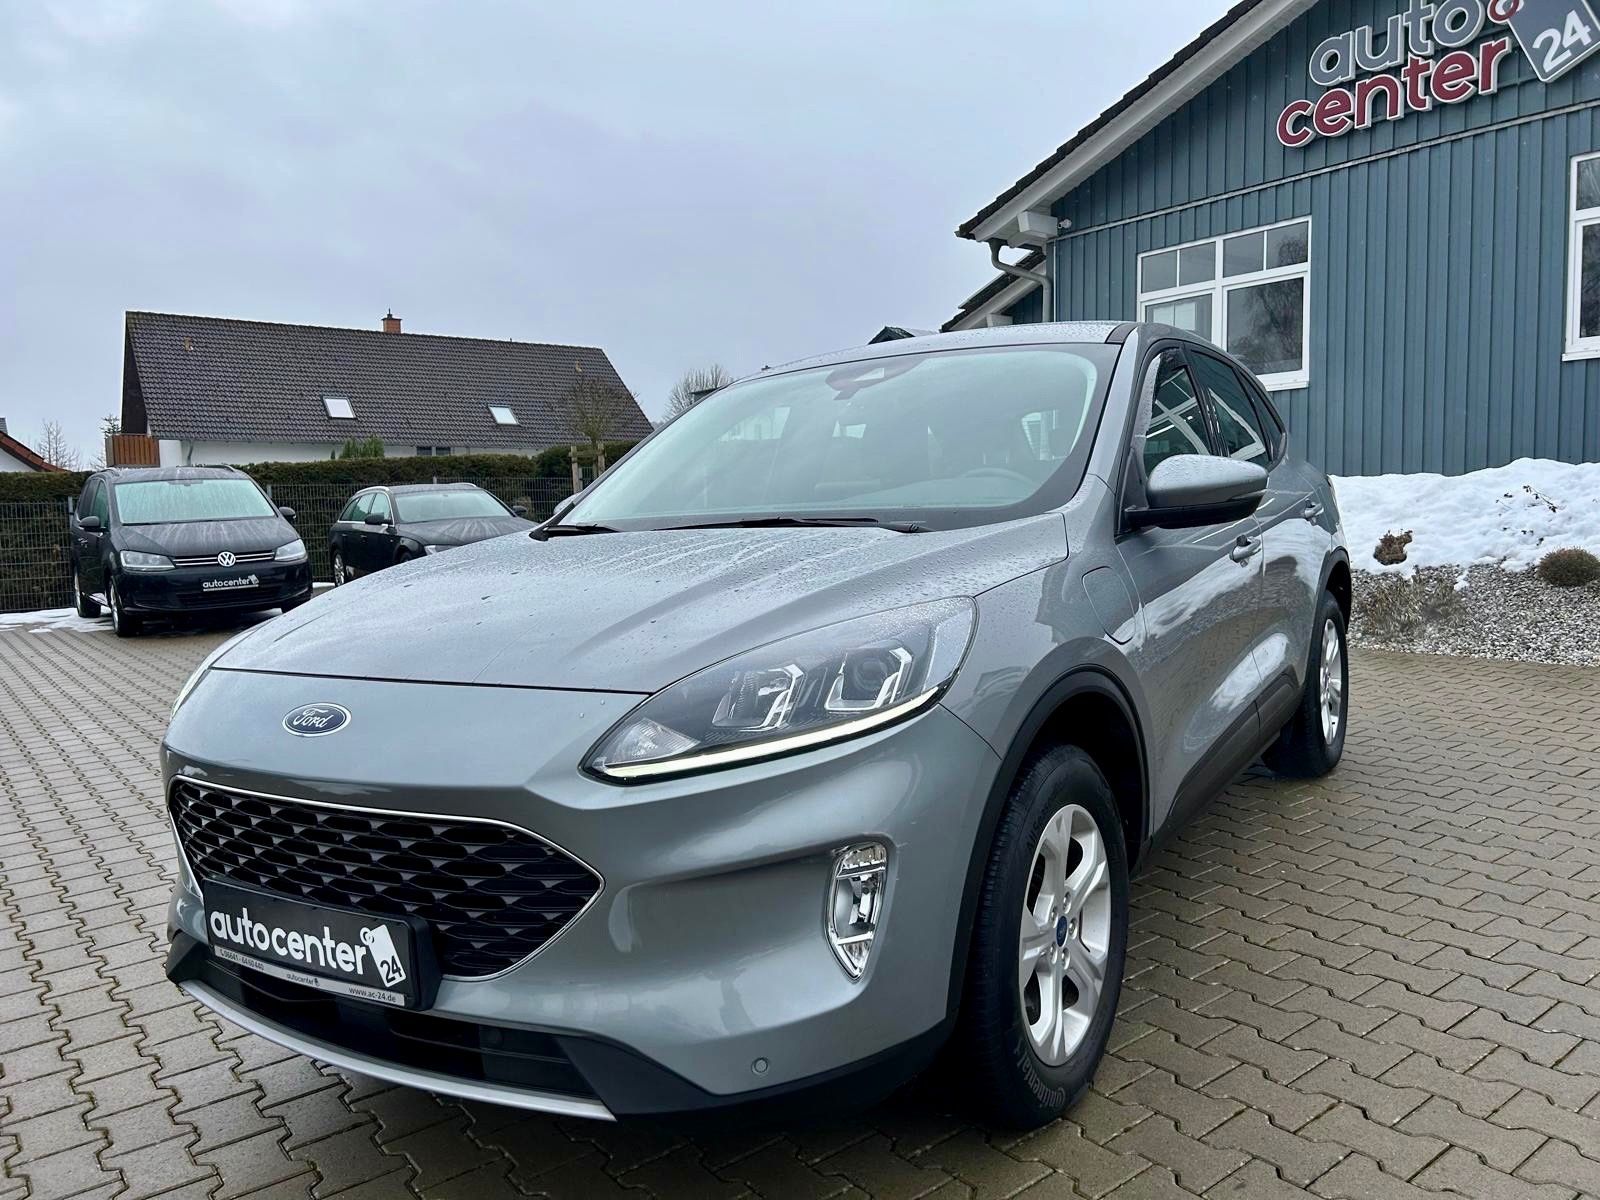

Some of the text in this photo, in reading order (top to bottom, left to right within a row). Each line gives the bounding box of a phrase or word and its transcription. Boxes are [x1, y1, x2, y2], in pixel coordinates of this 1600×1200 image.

[1309, 0, 1592, 85] auto 24
[1276, 36, 1511, 147] center
[293, 708, 334, 728] Ford
[210, 907, 403, 984] autocenter 24
[349, 986, 396, 1003] www.ac-24.de
[1016, 1051, 1066, 1108] Continental
